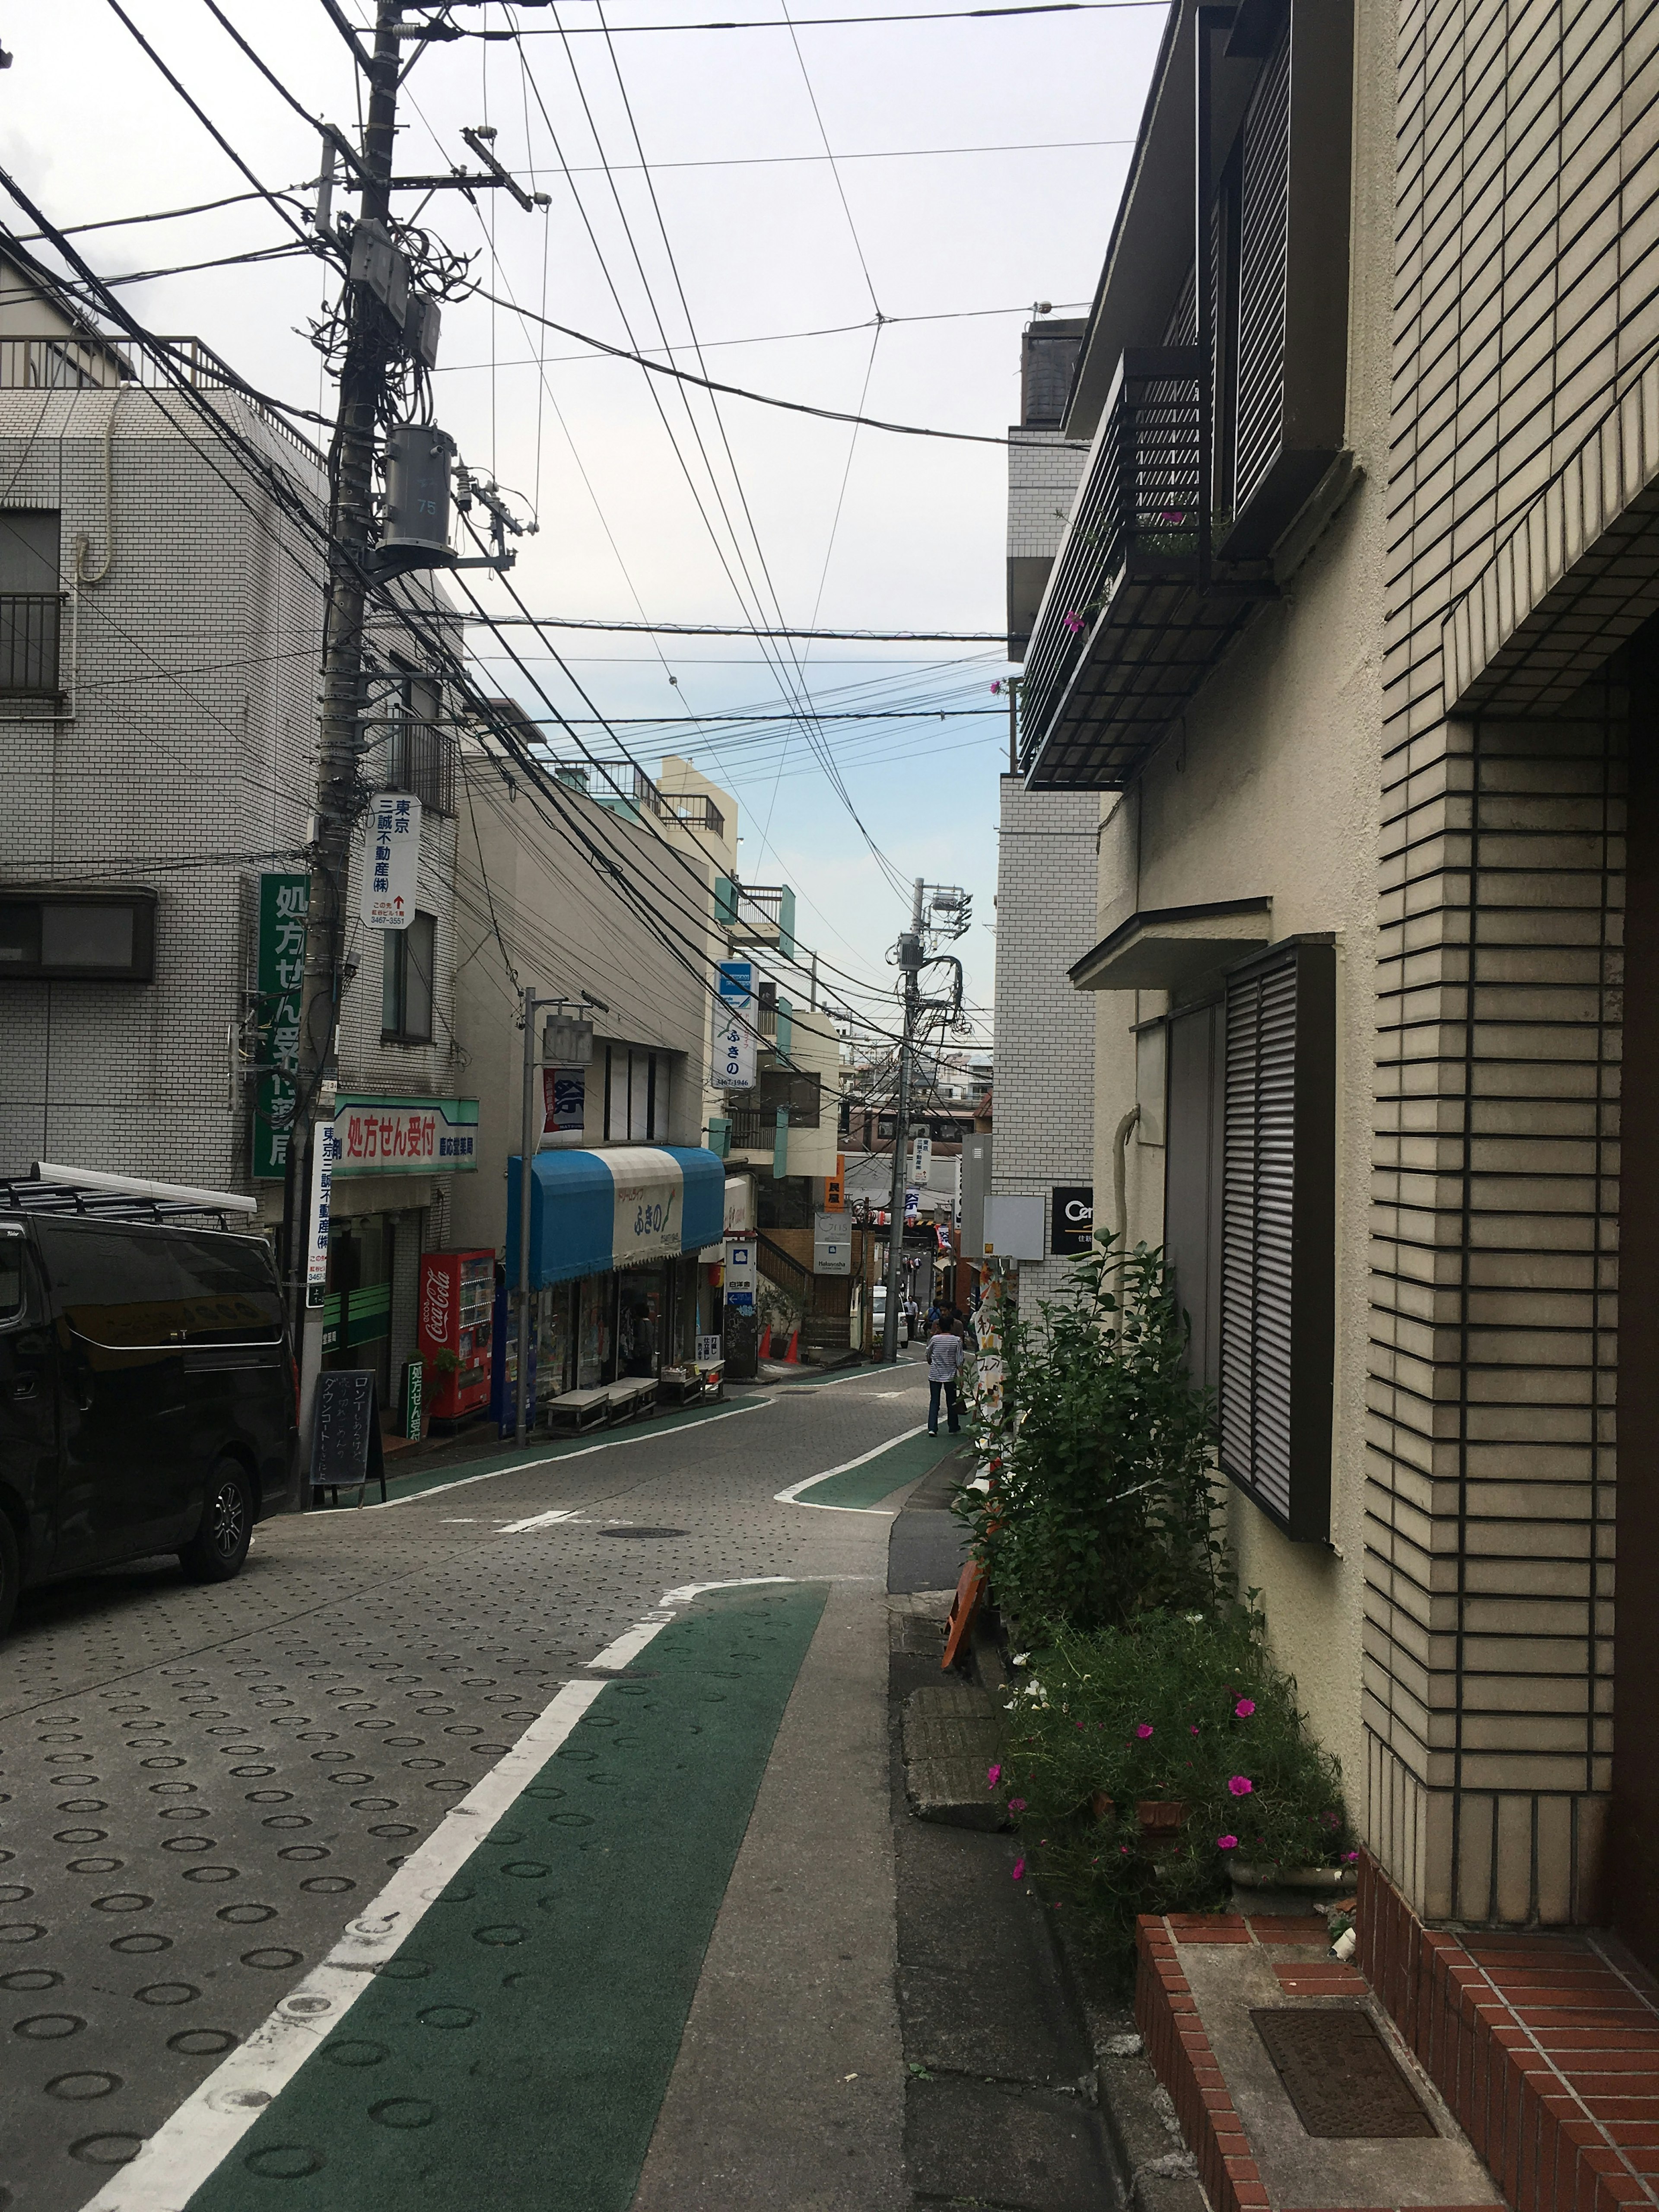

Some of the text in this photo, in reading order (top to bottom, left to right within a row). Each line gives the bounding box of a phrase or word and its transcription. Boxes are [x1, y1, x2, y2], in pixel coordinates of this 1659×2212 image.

[417, 499, 436, 515] 75
[394, 800, 411, 833] 東京
[371, 916, 404, 925] 3467-3551
[727, 1030, 740, 1074] ふきの
[347, 1115, 435, 1159] 処方せん受付
[634, 1204, 662, 1236] ふきの
[410, 1366, 422, 1442] 処方せん受付
